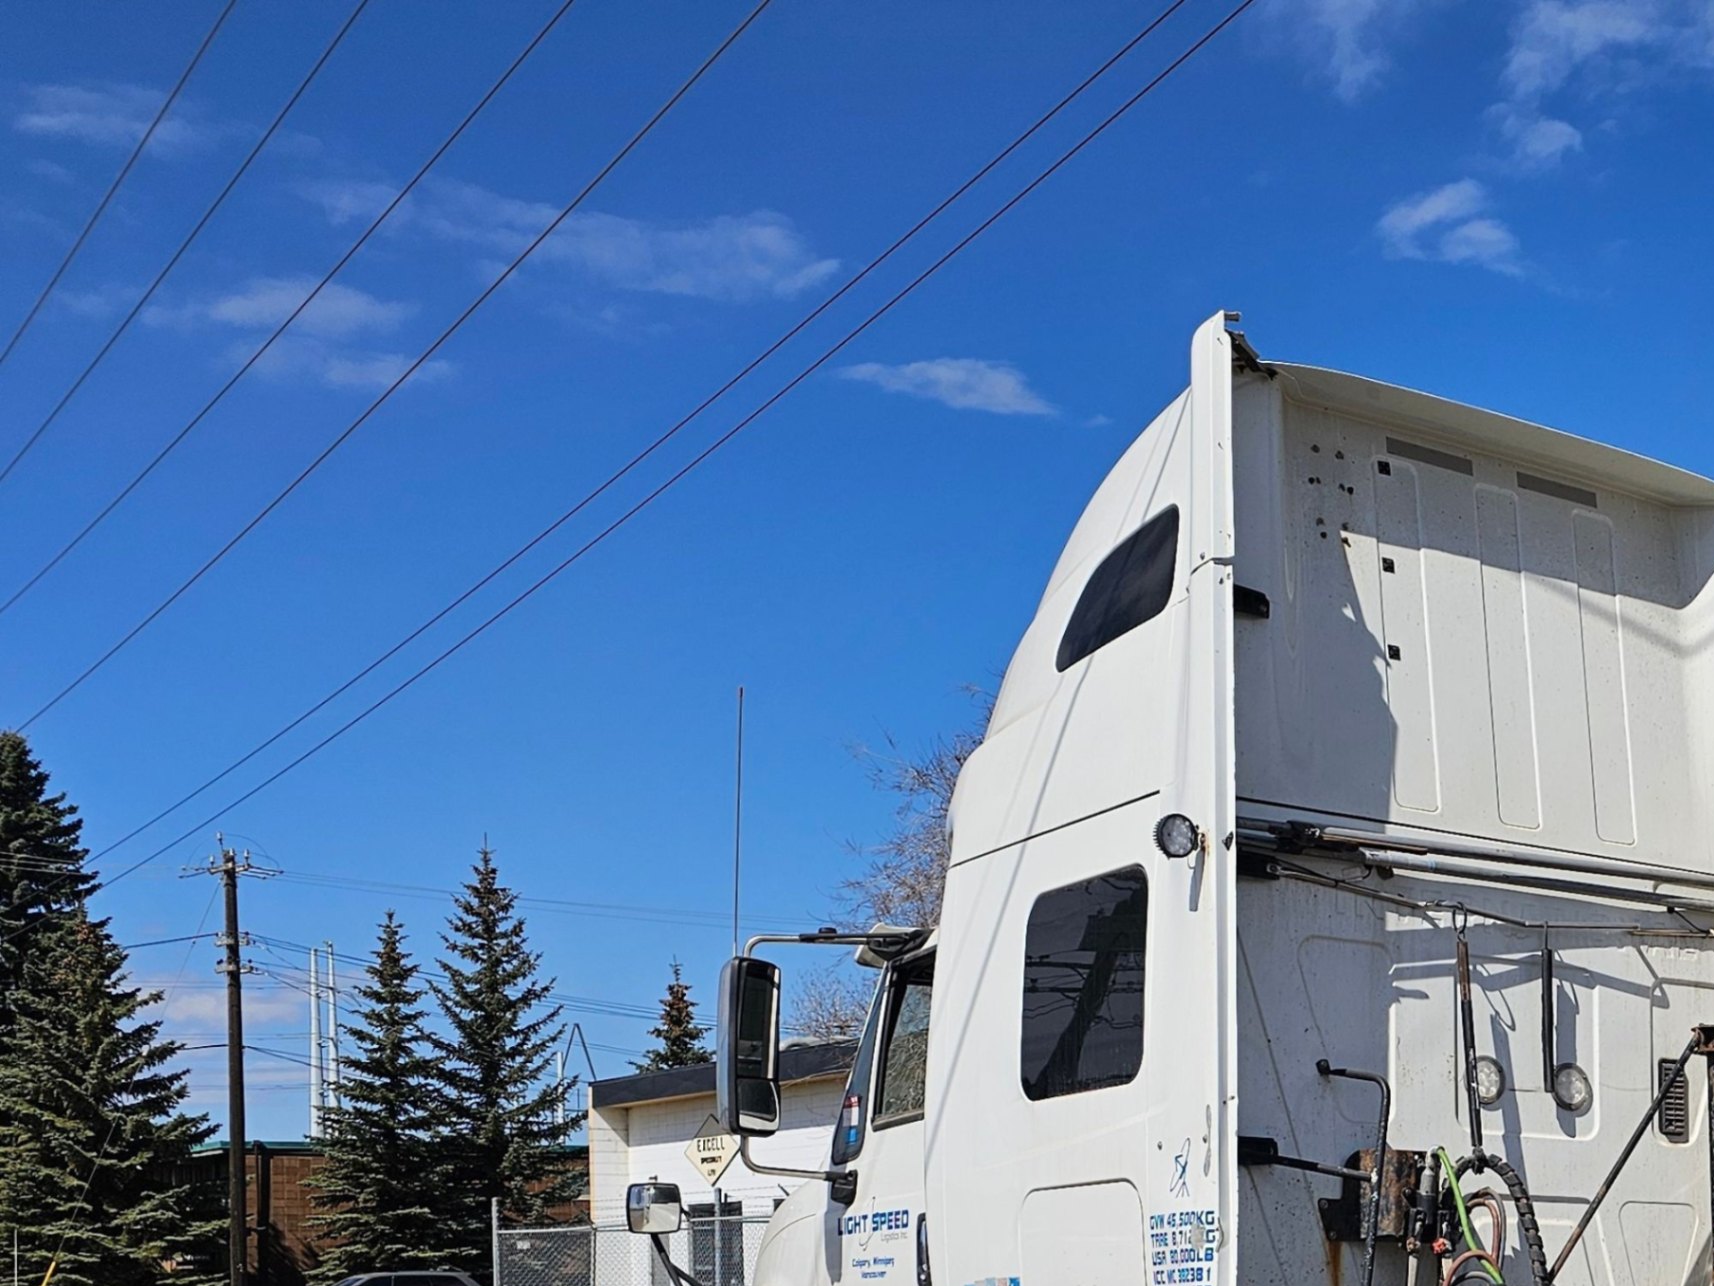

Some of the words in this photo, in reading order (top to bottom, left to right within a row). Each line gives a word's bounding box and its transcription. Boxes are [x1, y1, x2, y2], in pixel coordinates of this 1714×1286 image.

[837, 1214, 868, 1236] LIGHT
[871, 1209, 909, 1232] SPEED
[1151, 1232, 1169, 1249] TARE
[1152, 1250, 1167, 1266] USA
